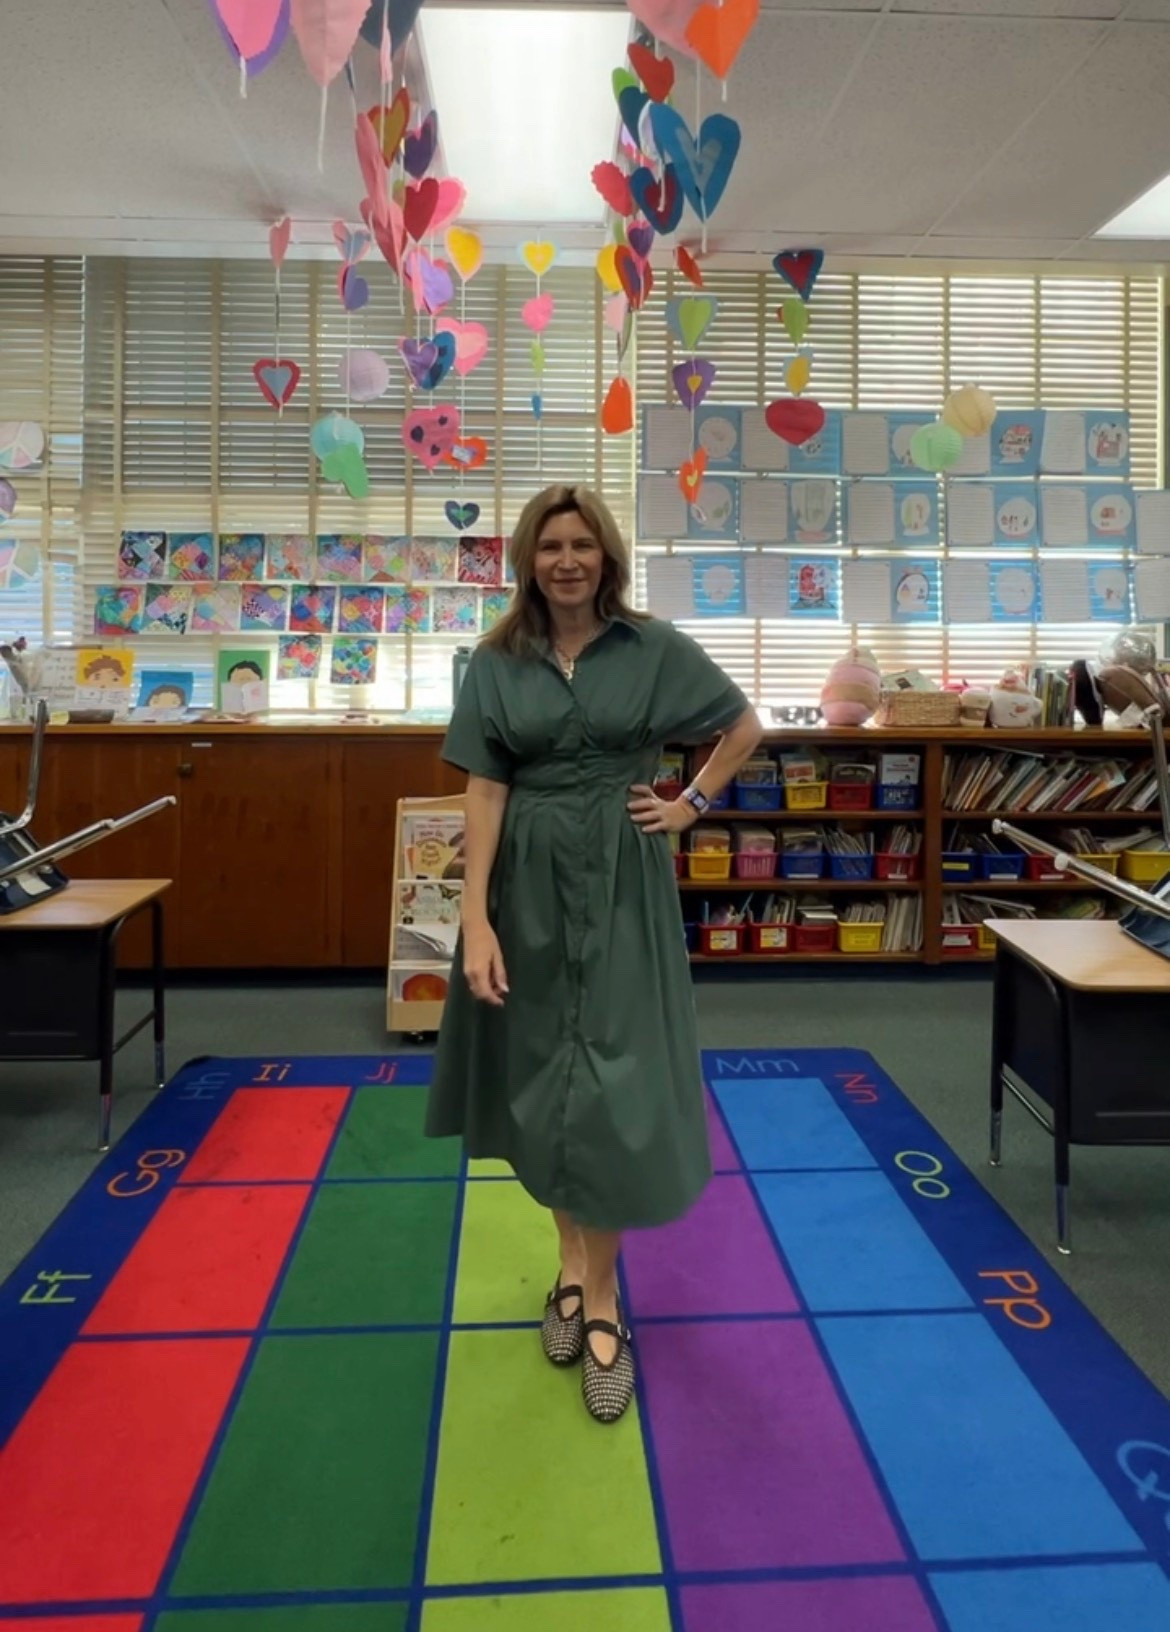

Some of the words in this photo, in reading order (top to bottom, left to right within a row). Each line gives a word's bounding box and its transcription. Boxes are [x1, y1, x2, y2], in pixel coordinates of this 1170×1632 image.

[365, 1062, 398, 1084] Jj
[715, 1056, 800, 1074] Mm
[176, 1071, 231, 1100] Hh
[835, 1072, 878, 1104] Nn
[106, 1148, 186, 1198] Gg
[19, 1269, 92, 1305] Ff
[977, 1269, 1052, 1330] Pp
